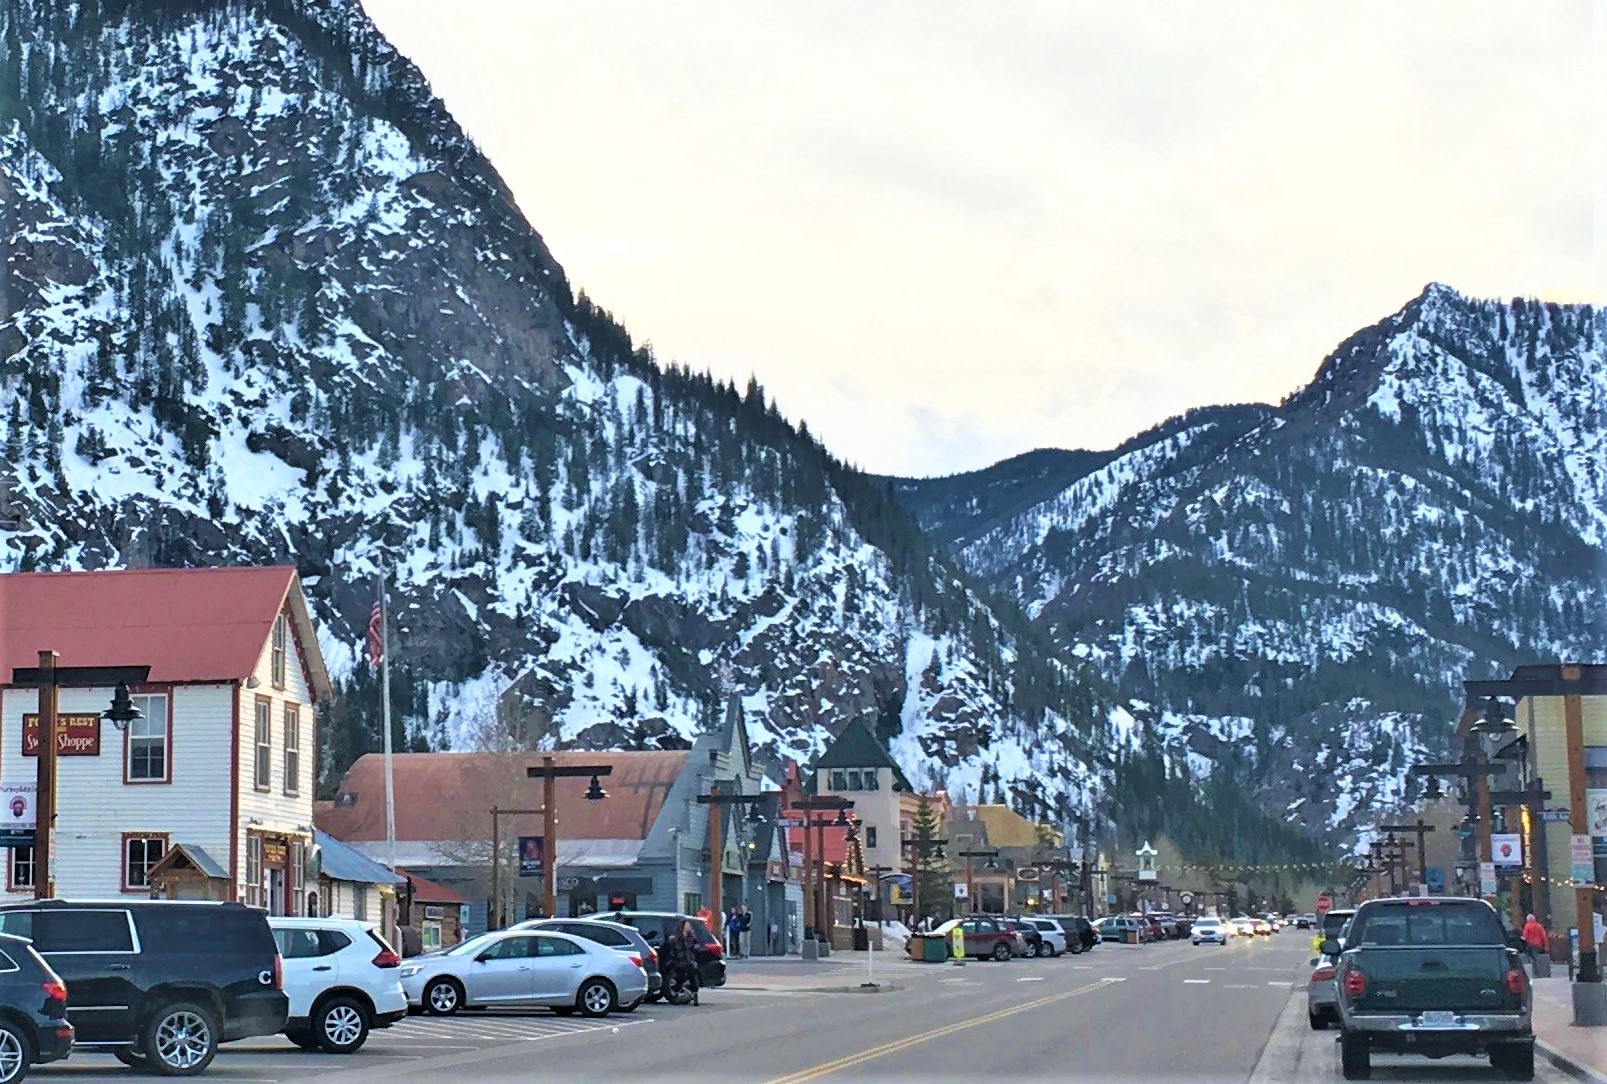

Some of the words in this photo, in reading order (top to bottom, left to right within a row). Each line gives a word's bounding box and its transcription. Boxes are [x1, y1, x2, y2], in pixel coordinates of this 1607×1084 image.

[69, 717, 95, 727] REST
[58, 733, 95, 751] Shoppe
[258, 970, 272, 984] C
